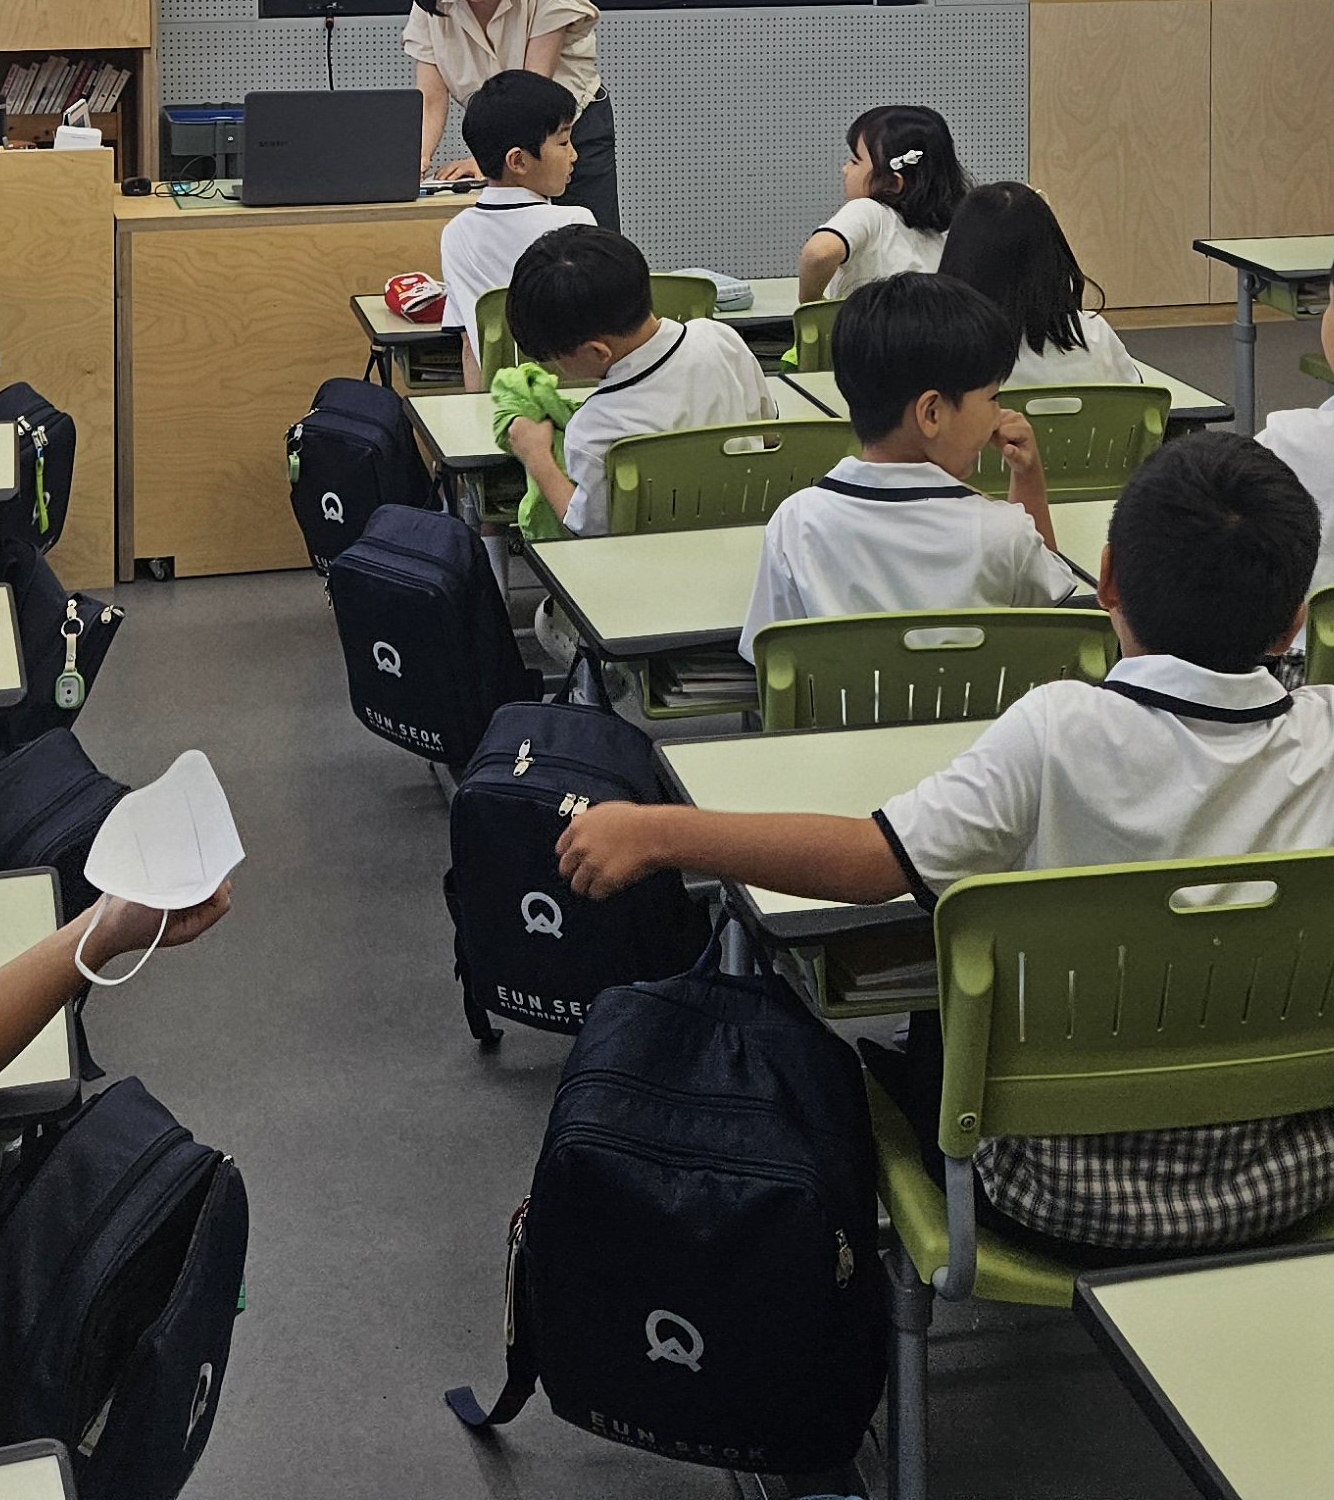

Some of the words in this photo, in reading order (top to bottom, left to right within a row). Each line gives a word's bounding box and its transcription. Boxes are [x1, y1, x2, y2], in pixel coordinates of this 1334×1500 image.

[365, 706, 393, 731] EUN
[399, 723, 442, 746] SEOK
[497, 985, 542, 1011] EUN
[553, 999, 591, 1016] SE
[499, 1001, 570, 1024] elementary
[590, 1410, 656, 1444] EUN
